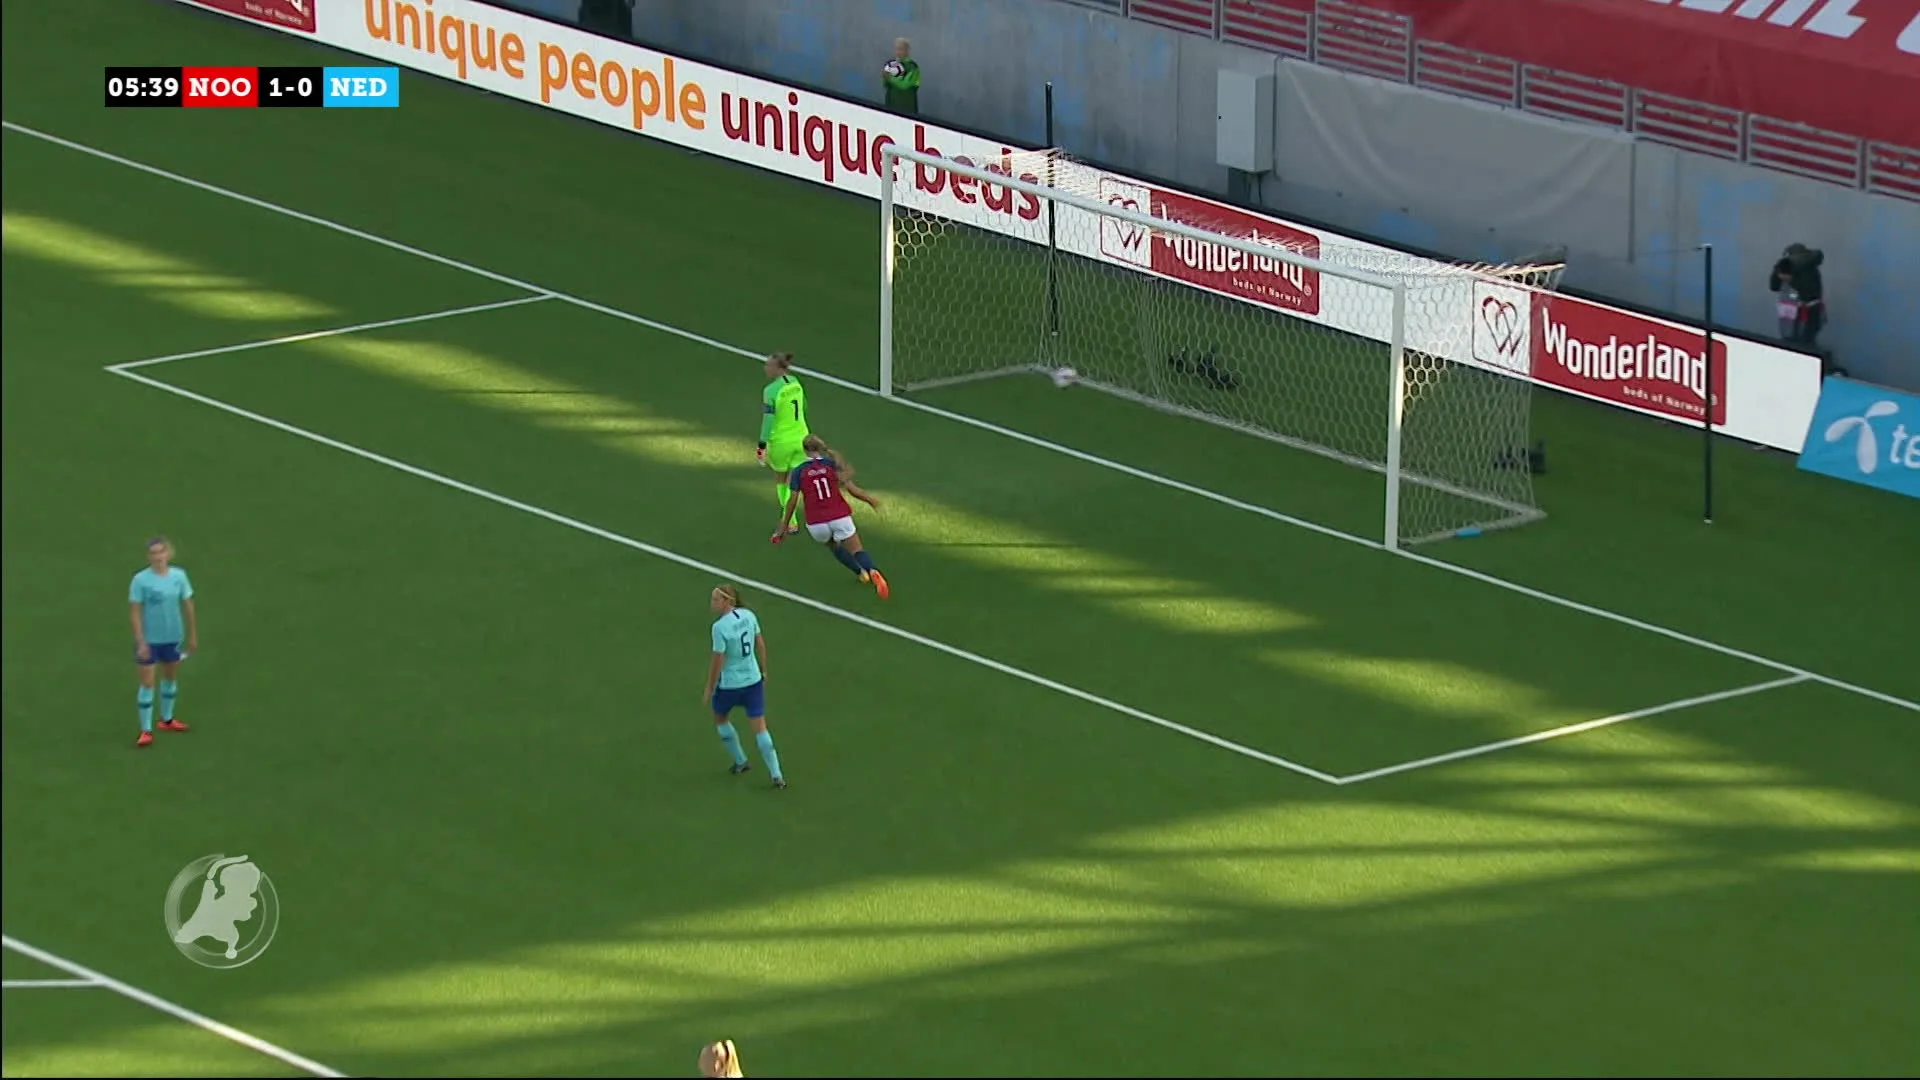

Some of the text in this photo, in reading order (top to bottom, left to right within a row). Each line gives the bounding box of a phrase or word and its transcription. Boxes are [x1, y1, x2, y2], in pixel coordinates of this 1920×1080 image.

[364, 0, 1041, 221] unique people unique beds
[1160, 202, 1304, 292] Wonderland
[1542, 306, 1707, 400] Wonderland
[790, 399, 799, 421] 1
[813, 477, 831, 500] 11
[740, 631, 751, 657] 6
